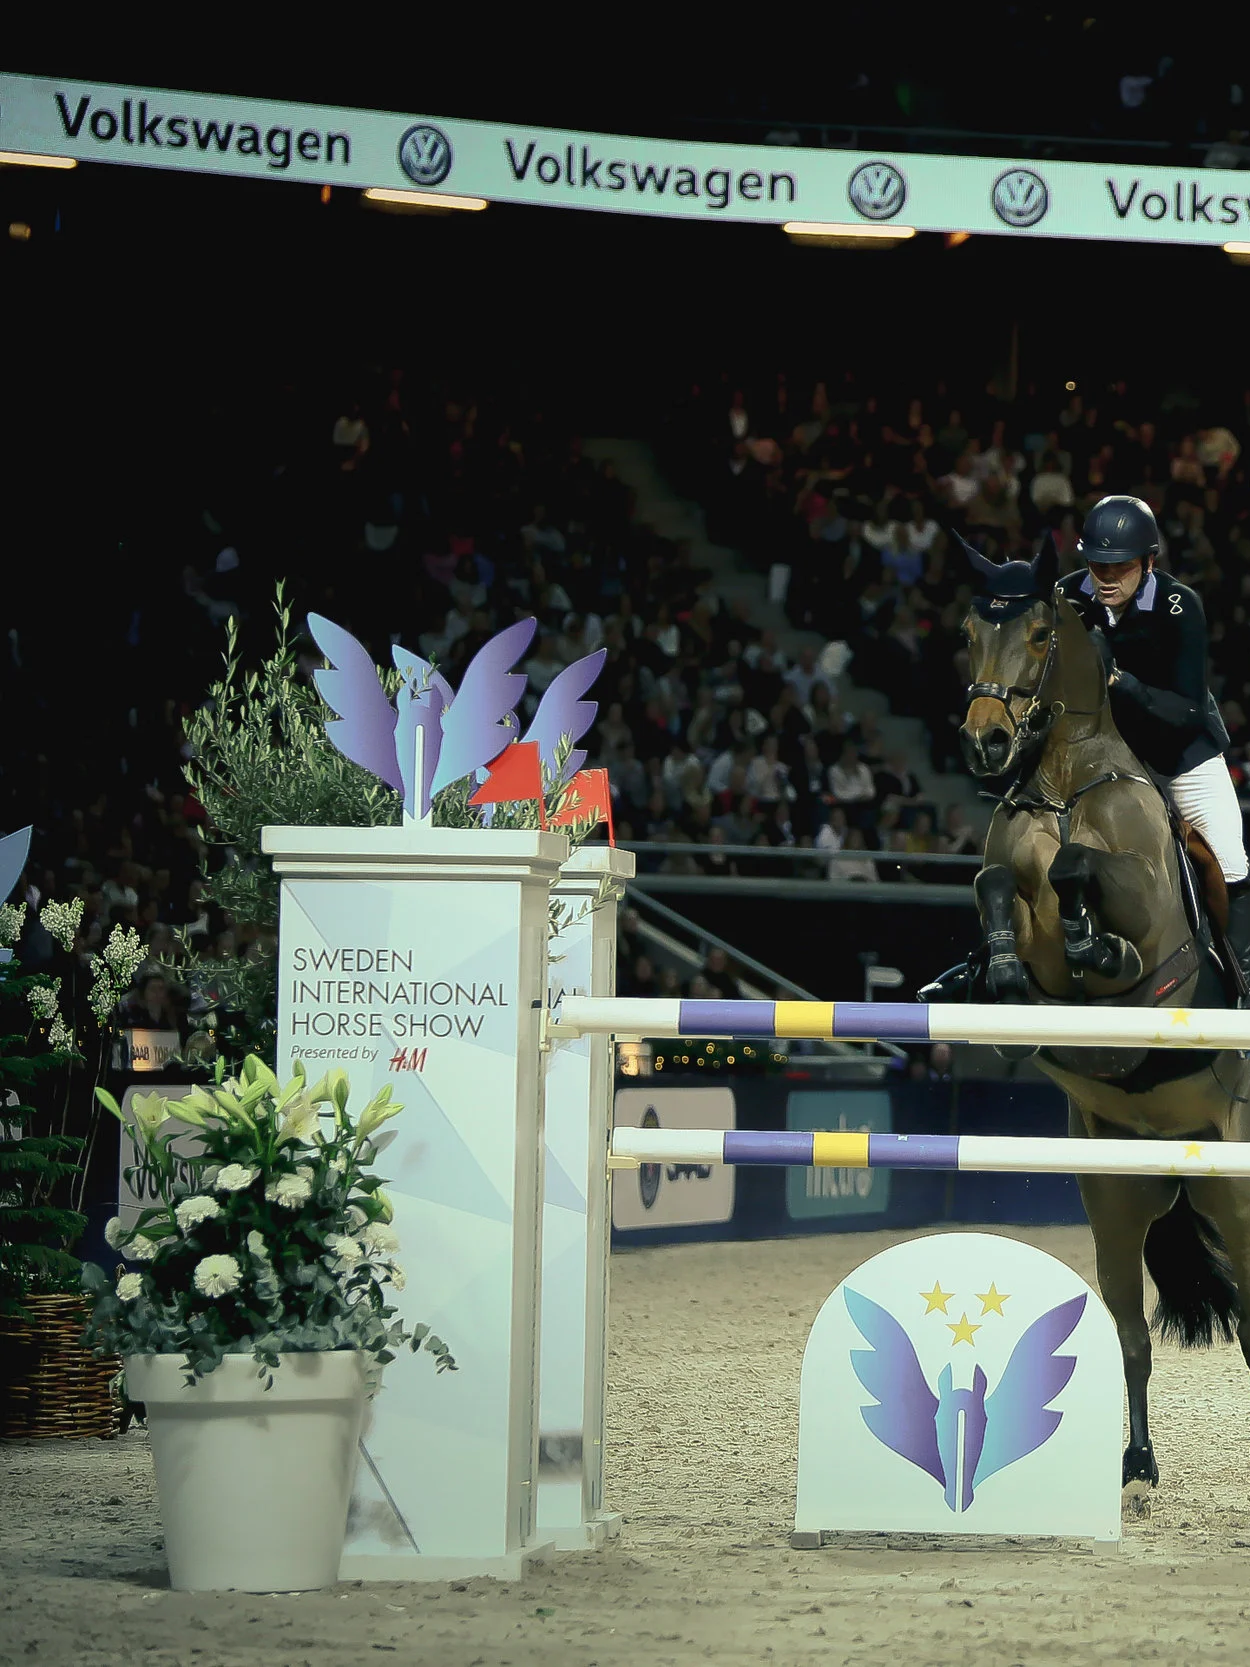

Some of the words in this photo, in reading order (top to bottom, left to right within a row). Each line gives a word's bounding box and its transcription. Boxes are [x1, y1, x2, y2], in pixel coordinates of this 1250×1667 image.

[54, 91, 352, 169] Volkswagen
[505, 138, 797, 208] Volkswagen
[292, 948, 413, 973] SWEDEN
[291, 980, 509, 1007] INTERNATIONAL
[291, 1012, 383, 1037] HORSE
[393, 1013, 485, 1039] SHOW
[290, 1044, 359, 1060] Presented
[361, 1045, 380, 1063] by
[388, 1047, 428, 1073] H&M
